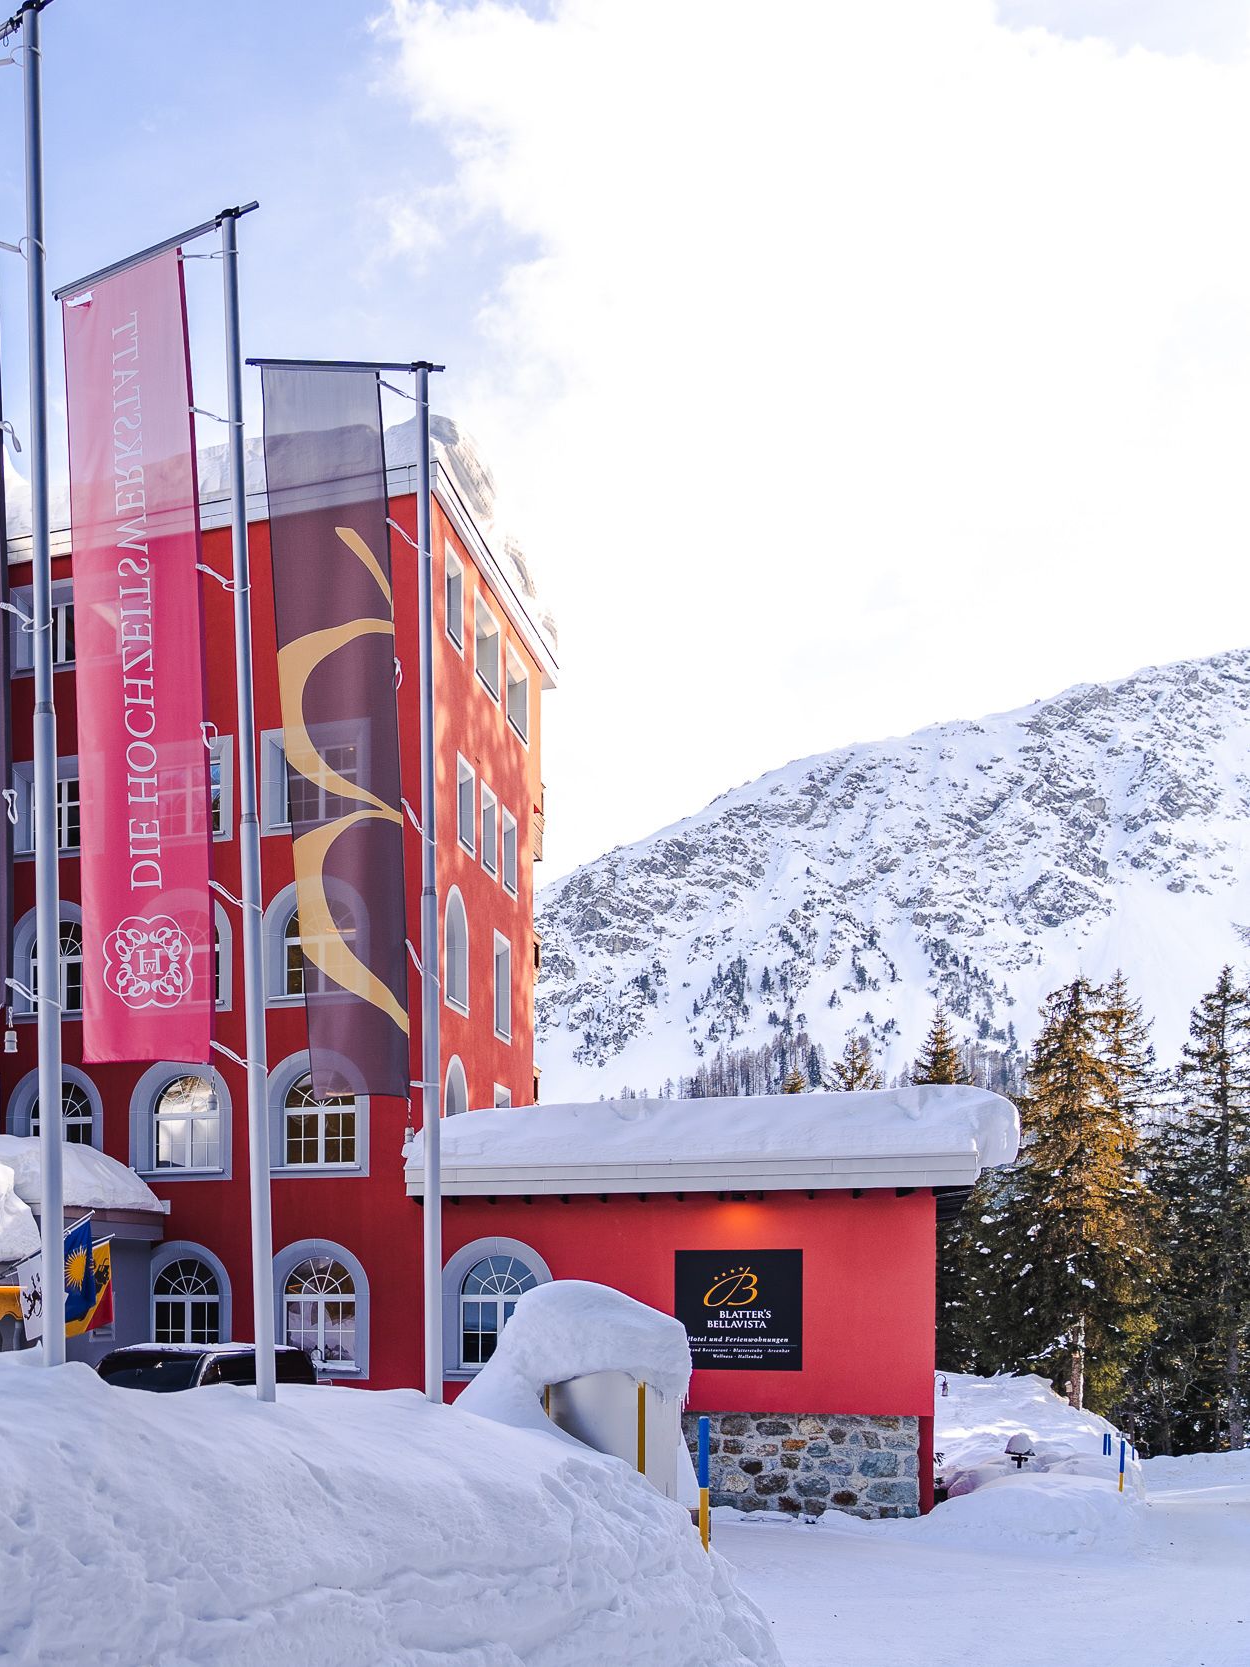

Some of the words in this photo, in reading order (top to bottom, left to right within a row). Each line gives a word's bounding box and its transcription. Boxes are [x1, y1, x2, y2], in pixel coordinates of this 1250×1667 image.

[719, 1309, 772, 1319] BLATTER'S
[707, 1320, 767, 1329] BELLAVISTA
[725, 1336, 789, 1344] Ferienwohnungen
